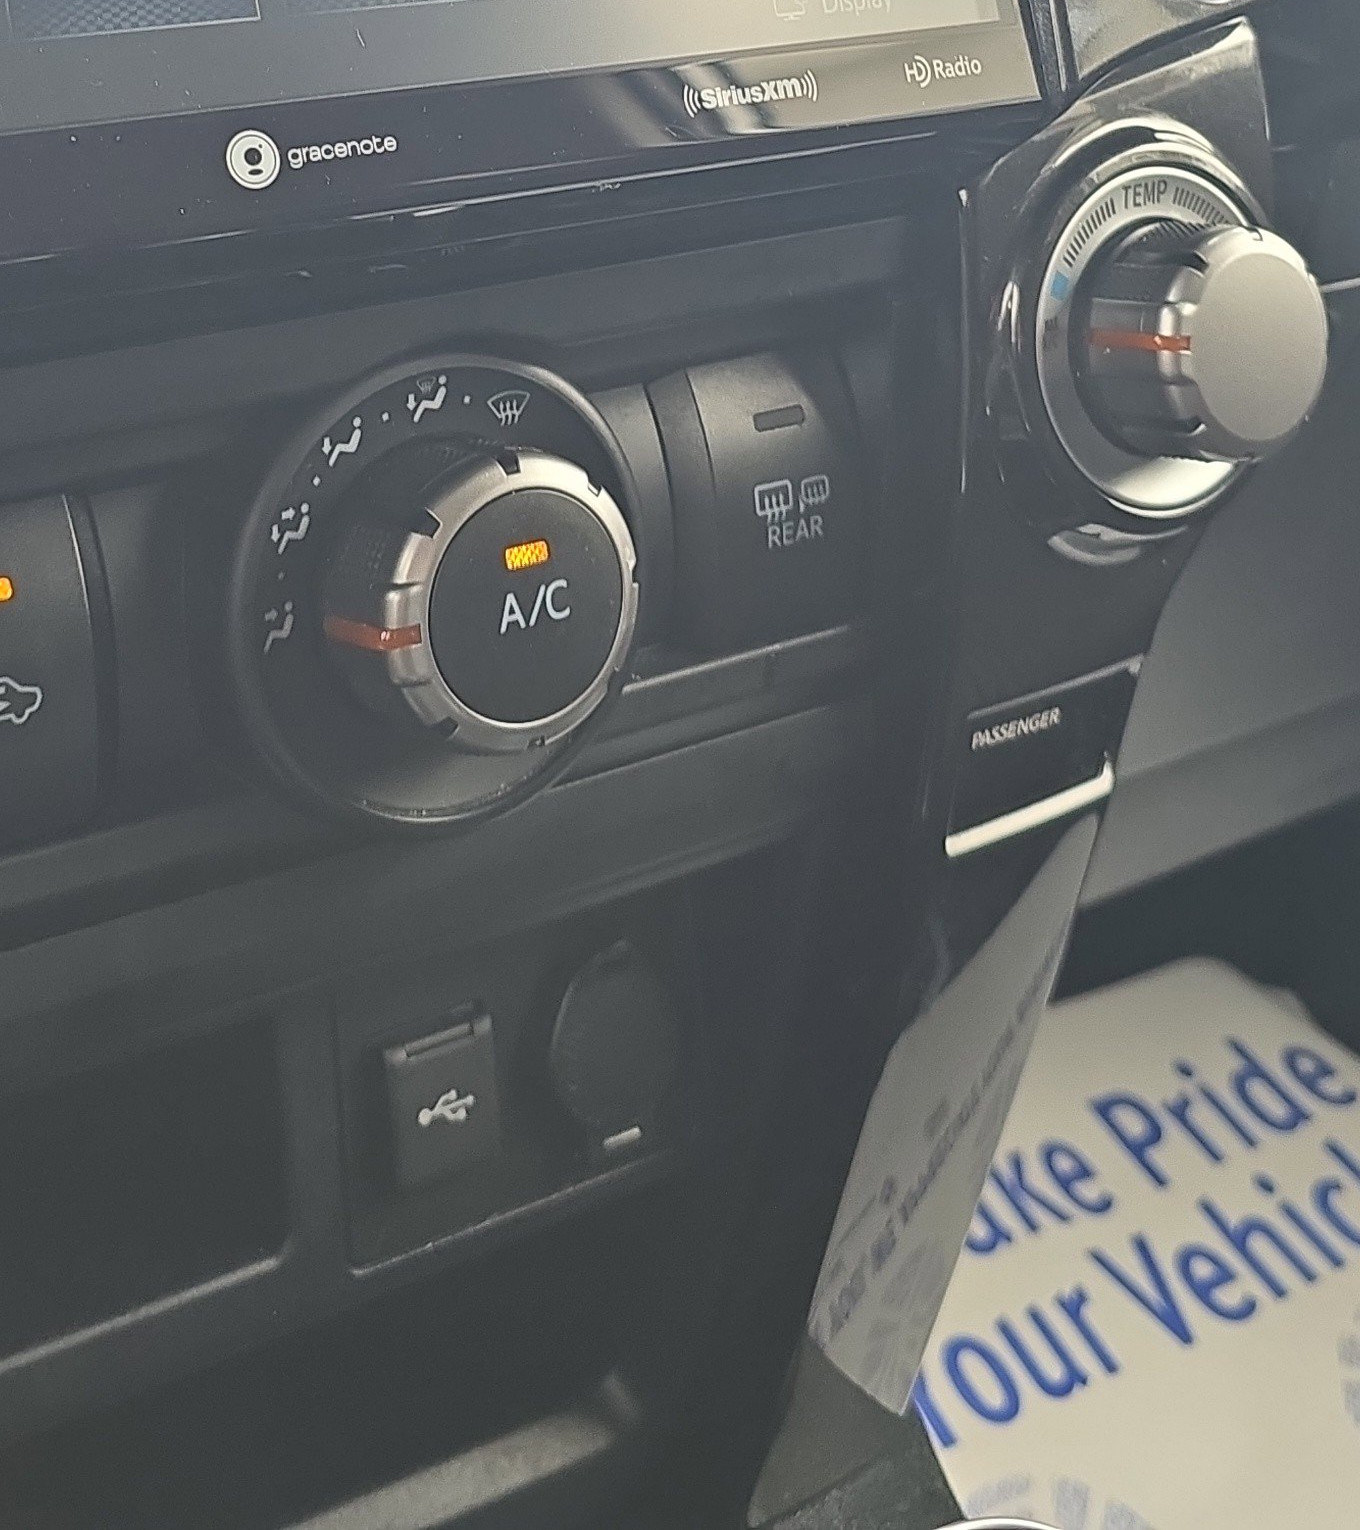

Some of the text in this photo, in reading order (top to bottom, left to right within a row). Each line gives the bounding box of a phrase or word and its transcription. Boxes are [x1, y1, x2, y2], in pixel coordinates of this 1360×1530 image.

[934, 56, 982, 79] Radio
[287, 135, 398, 170] gracenote
[1121, 180, 1168, 209] TEMP
[768, 516, 824, 549] REAR
[500, 578, 571, 634] A/C
[971, 706, 1061, 751] PASSENGER
[965, 1035, 1358, 1255] ake Pride
